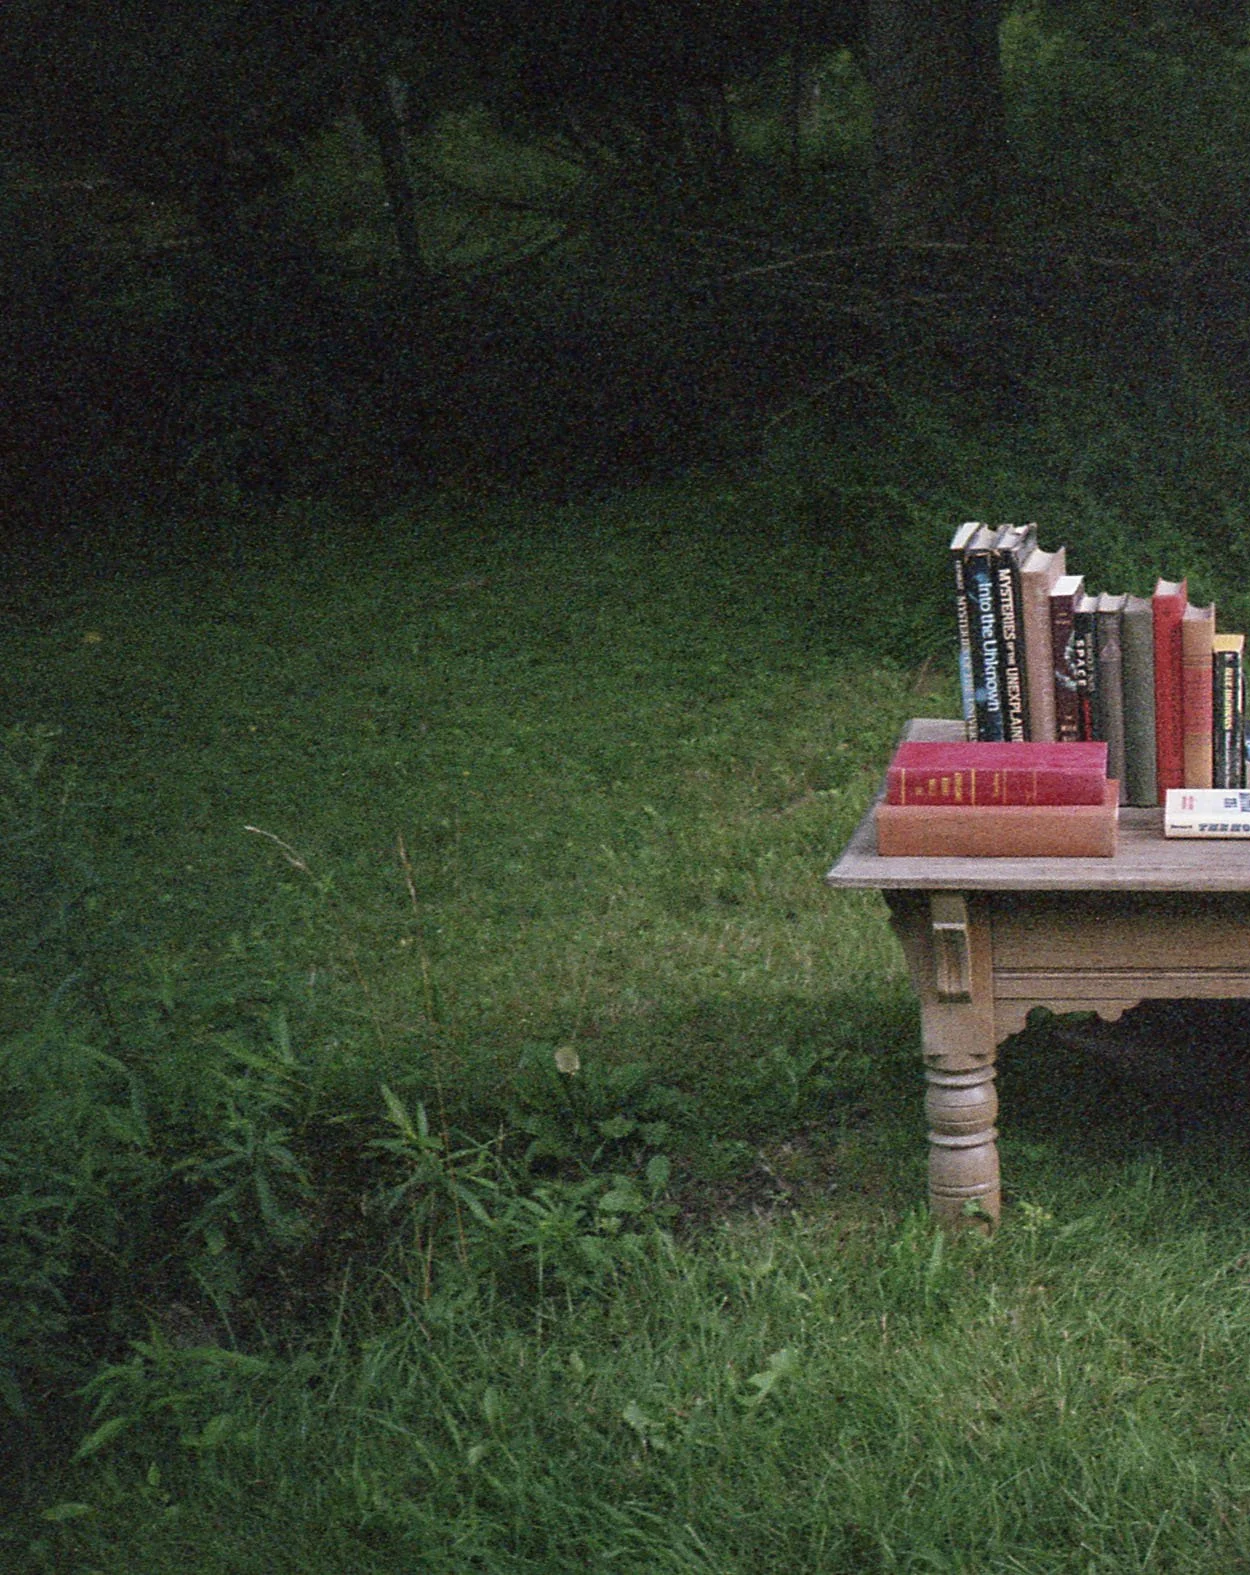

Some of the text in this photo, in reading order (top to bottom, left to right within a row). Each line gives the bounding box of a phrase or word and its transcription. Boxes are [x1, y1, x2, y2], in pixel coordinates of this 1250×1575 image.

[998, 568, 1016, 640] MYSTERIES
[977, 582, 1000, 712] Into the Unknown
[1076, 639, 1087, 688] SPACE
